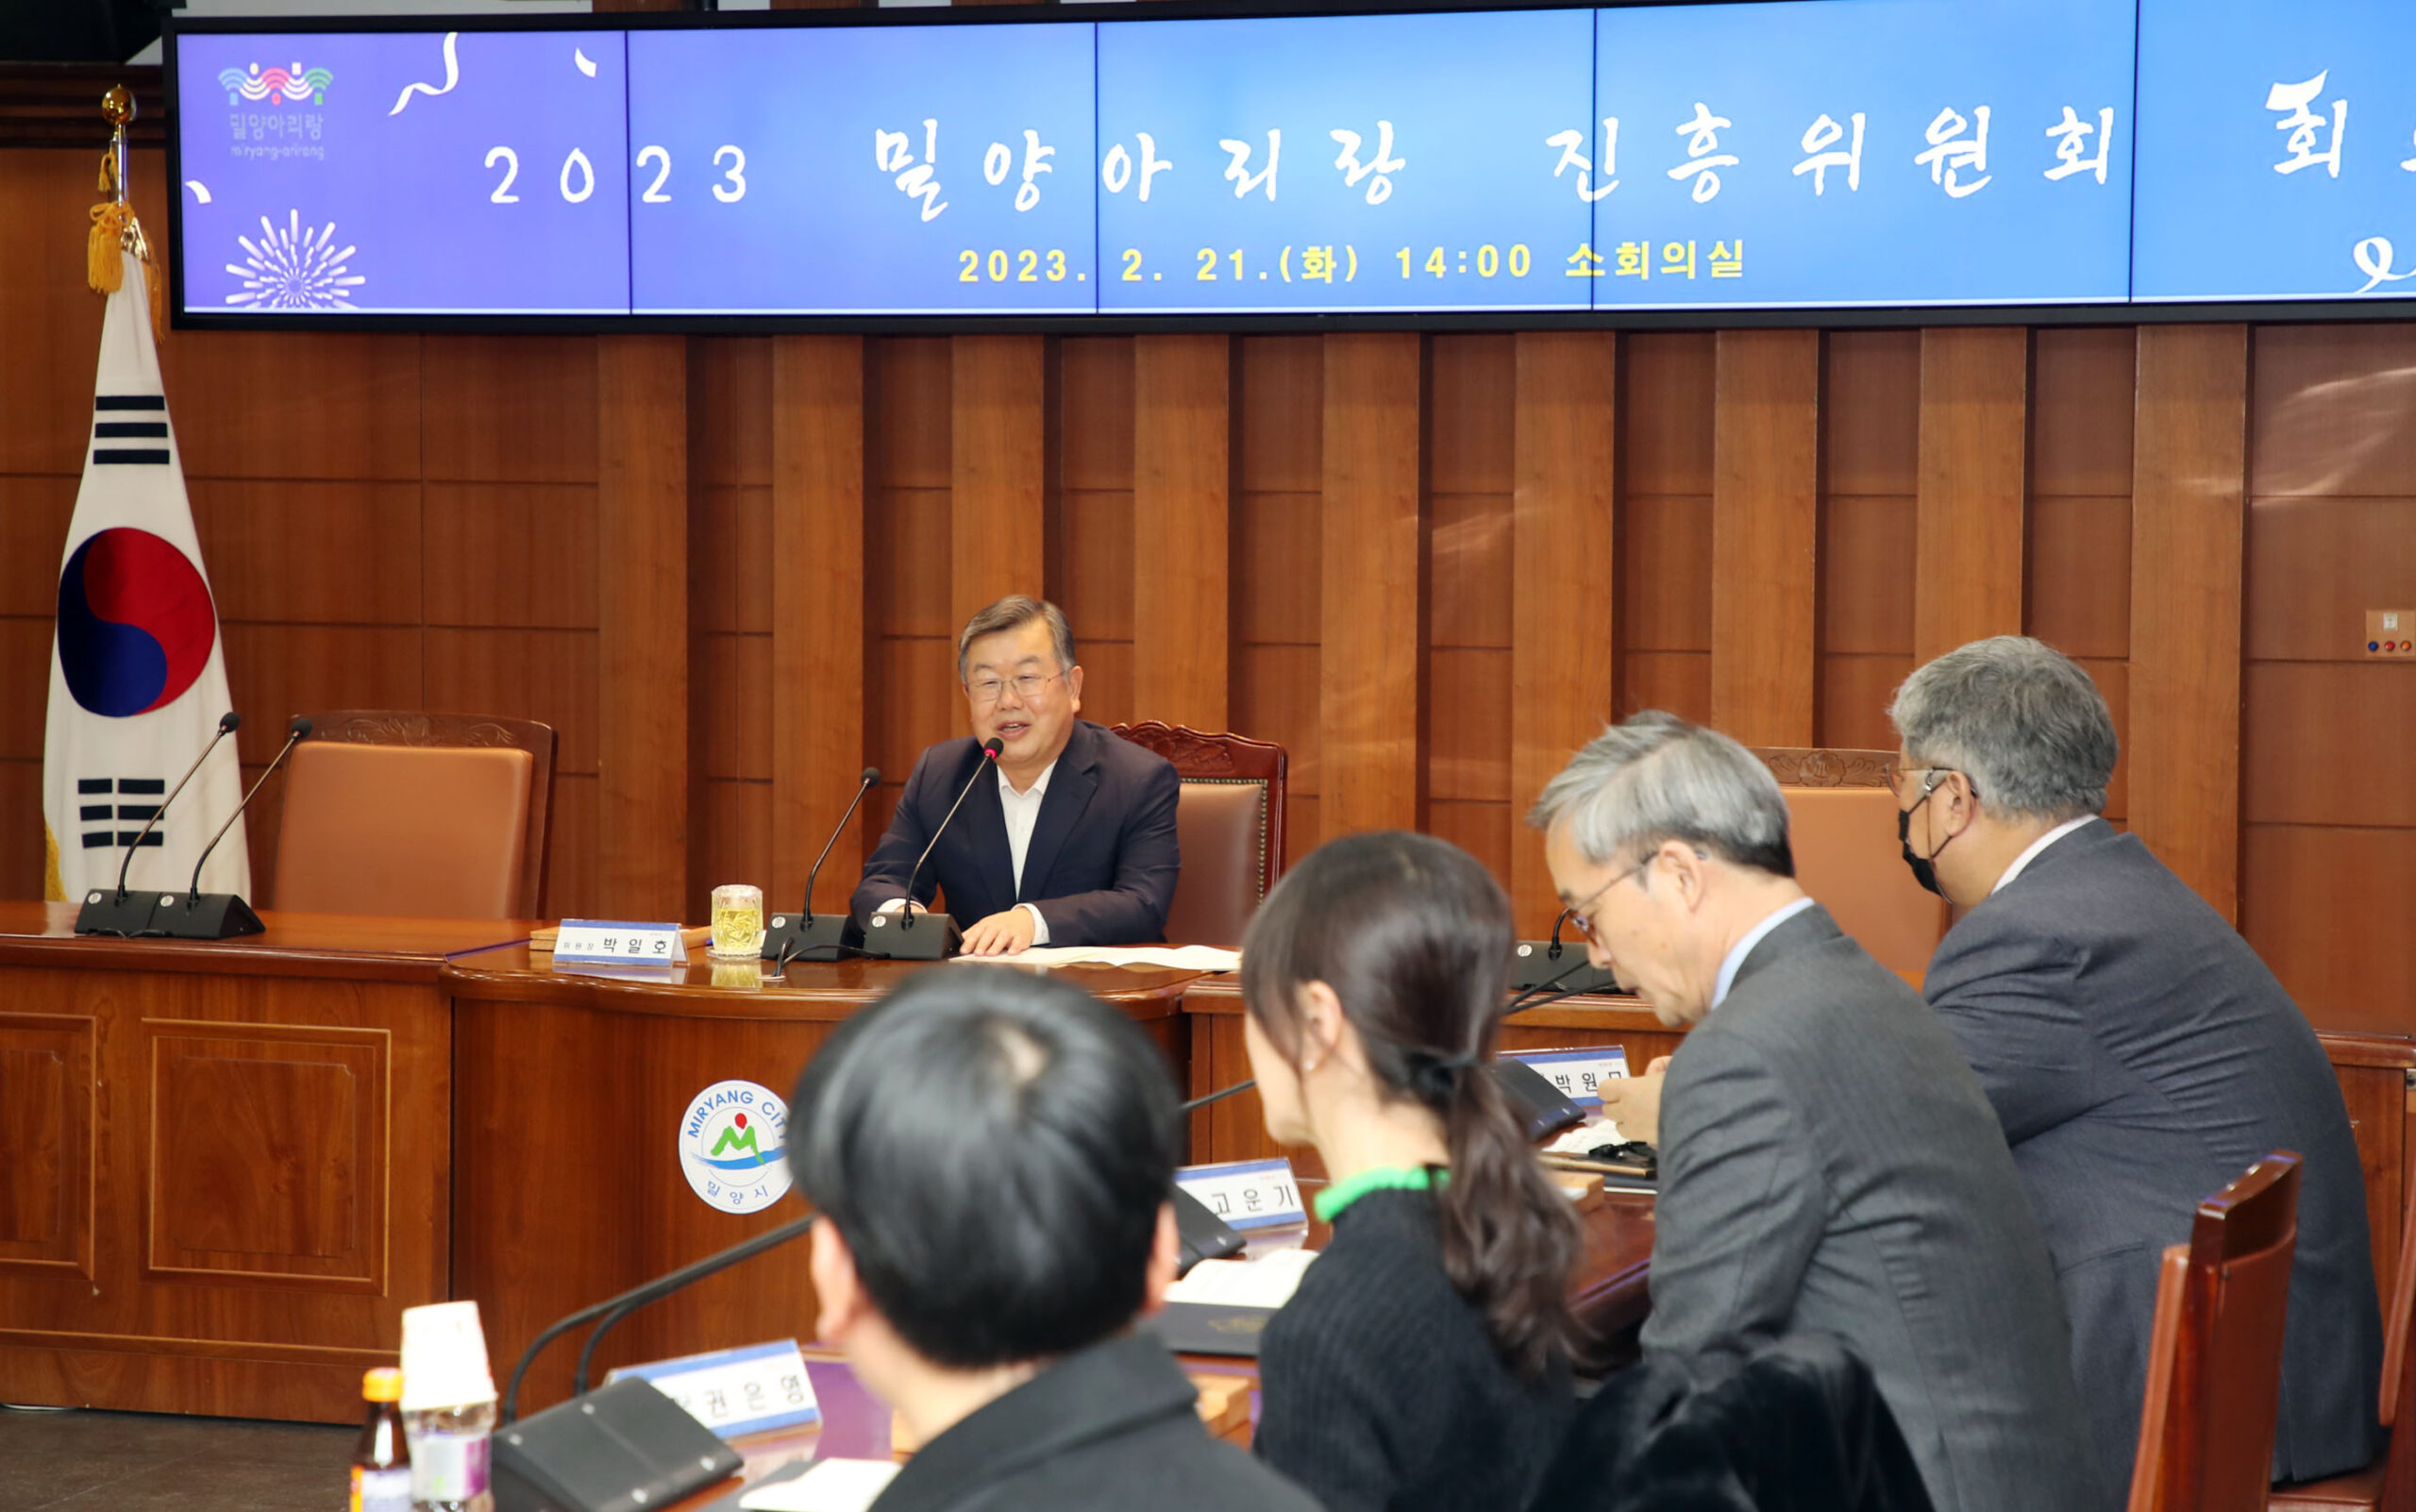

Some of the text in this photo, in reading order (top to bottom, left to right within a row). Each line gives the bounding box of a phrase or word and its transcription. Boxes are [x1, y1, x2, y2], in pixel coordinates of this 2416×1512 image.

[229, 113, 324, 141] 밀양아리랑
[484, 94, 2416, 223] 2023 밀양아리랑 진흥위원회 회
[959, 240, 1743, 283] 2023. 2. 21.(화) 14:00 소회의실
[603, 937, 666, 954] 박일호
[1555, 1070, 1622, 1093] 박원
[688, 1090, 754, 1138] MIRYANG
[708, 1181, 768, 1205] 밀양시
[1211, 1184, 1295, 1216] 고운기
